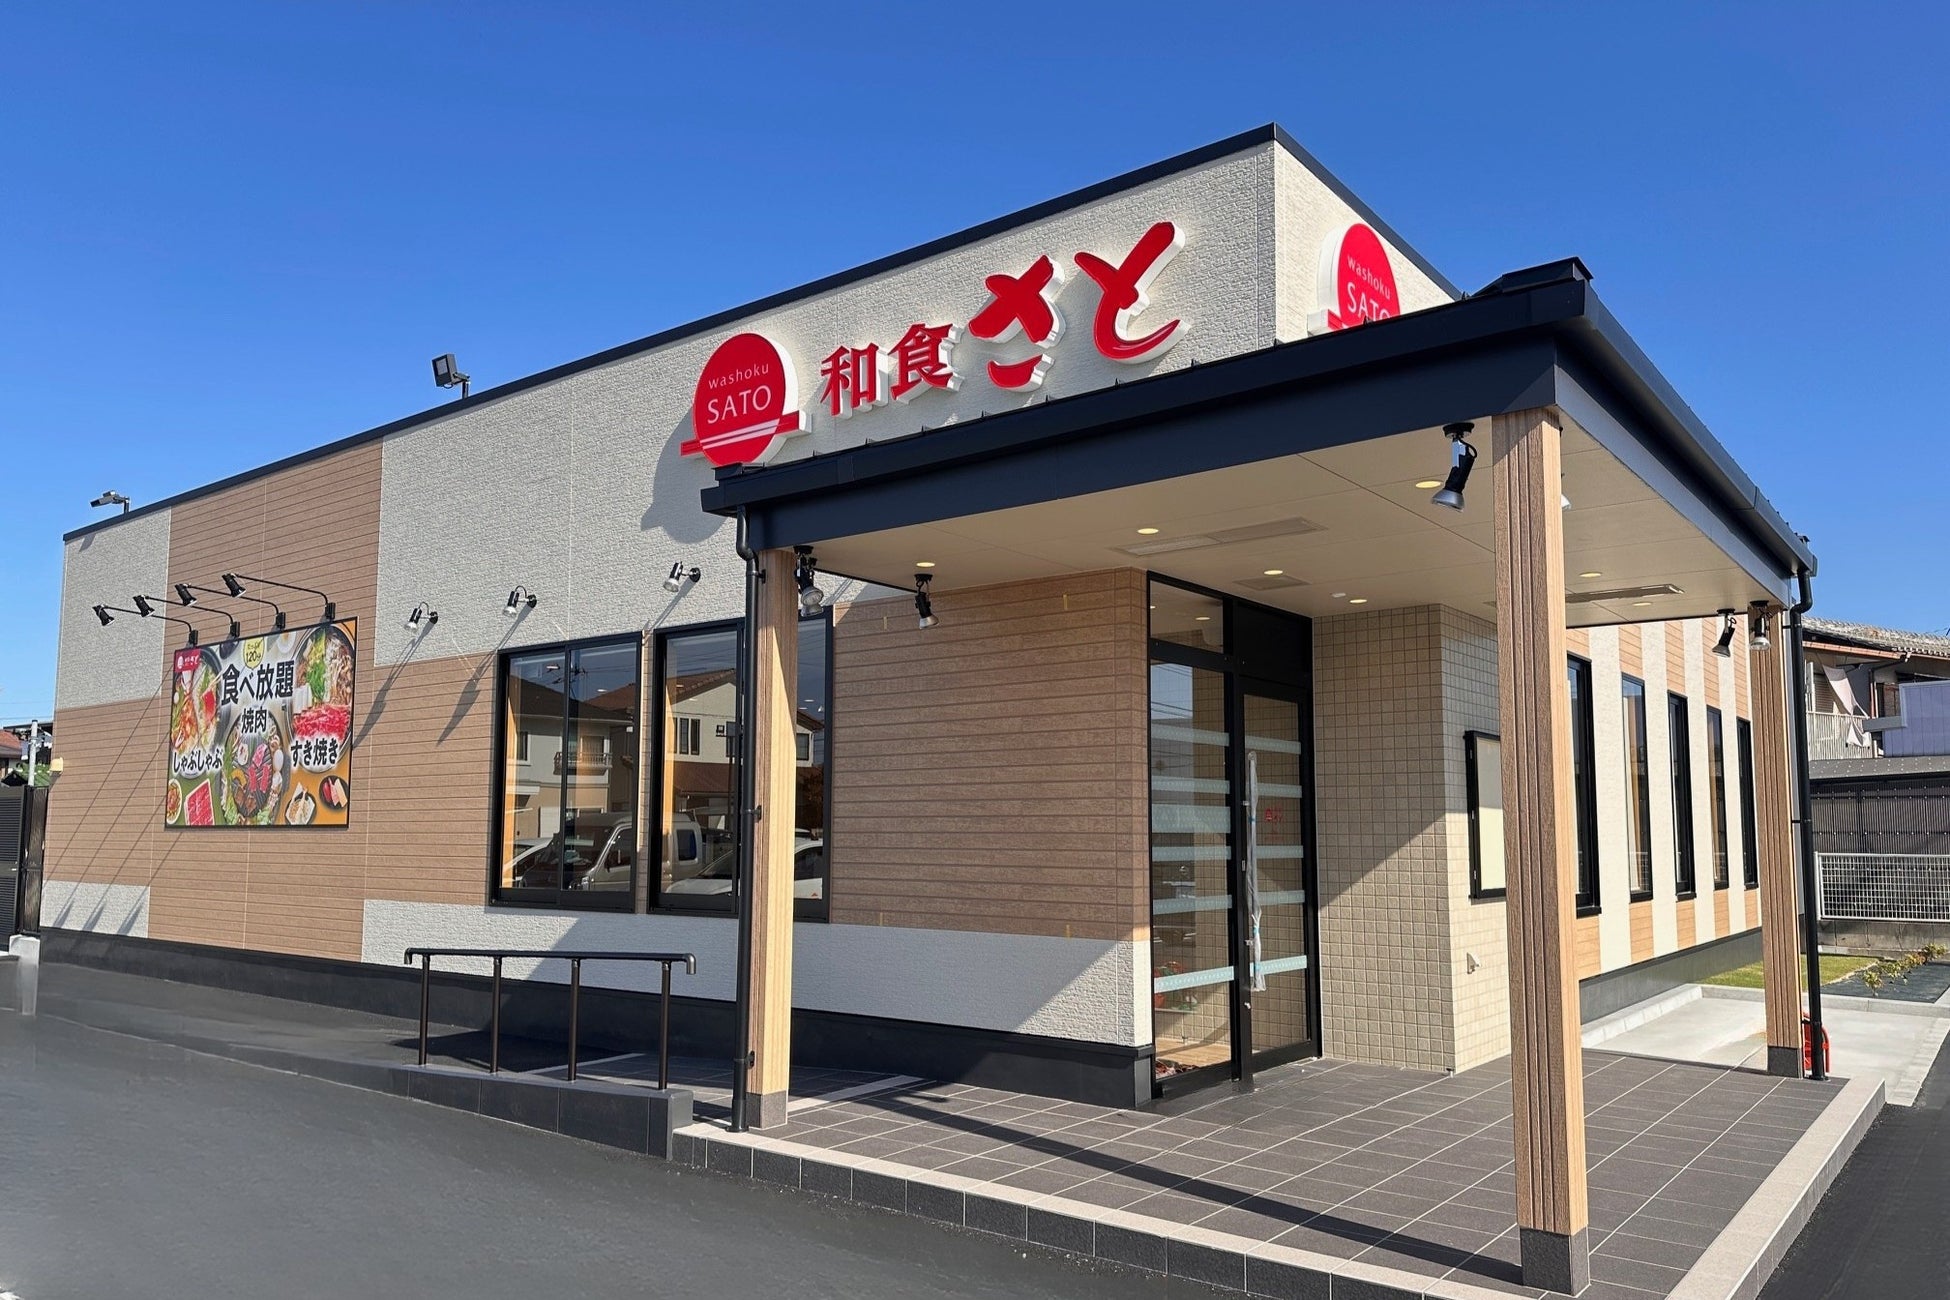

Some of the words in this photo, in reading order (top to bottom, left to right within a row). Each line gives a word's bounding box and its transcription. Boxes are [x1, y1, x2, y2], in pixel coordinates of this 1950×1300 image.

[1347, 255, 1391, 300] washoku
[820, 222, 1182, 416] 和食さと
[708, 363, 769, 390] washoku
[707, 385, 771, 424] SATO
[221, 660, 295, 706] 食べ放題
[241, 706, 267, 734] 焼肉
[173, 748, 223, 773] しゃぶしゃぶ
[291, 738, 338, 767] すき焼き
